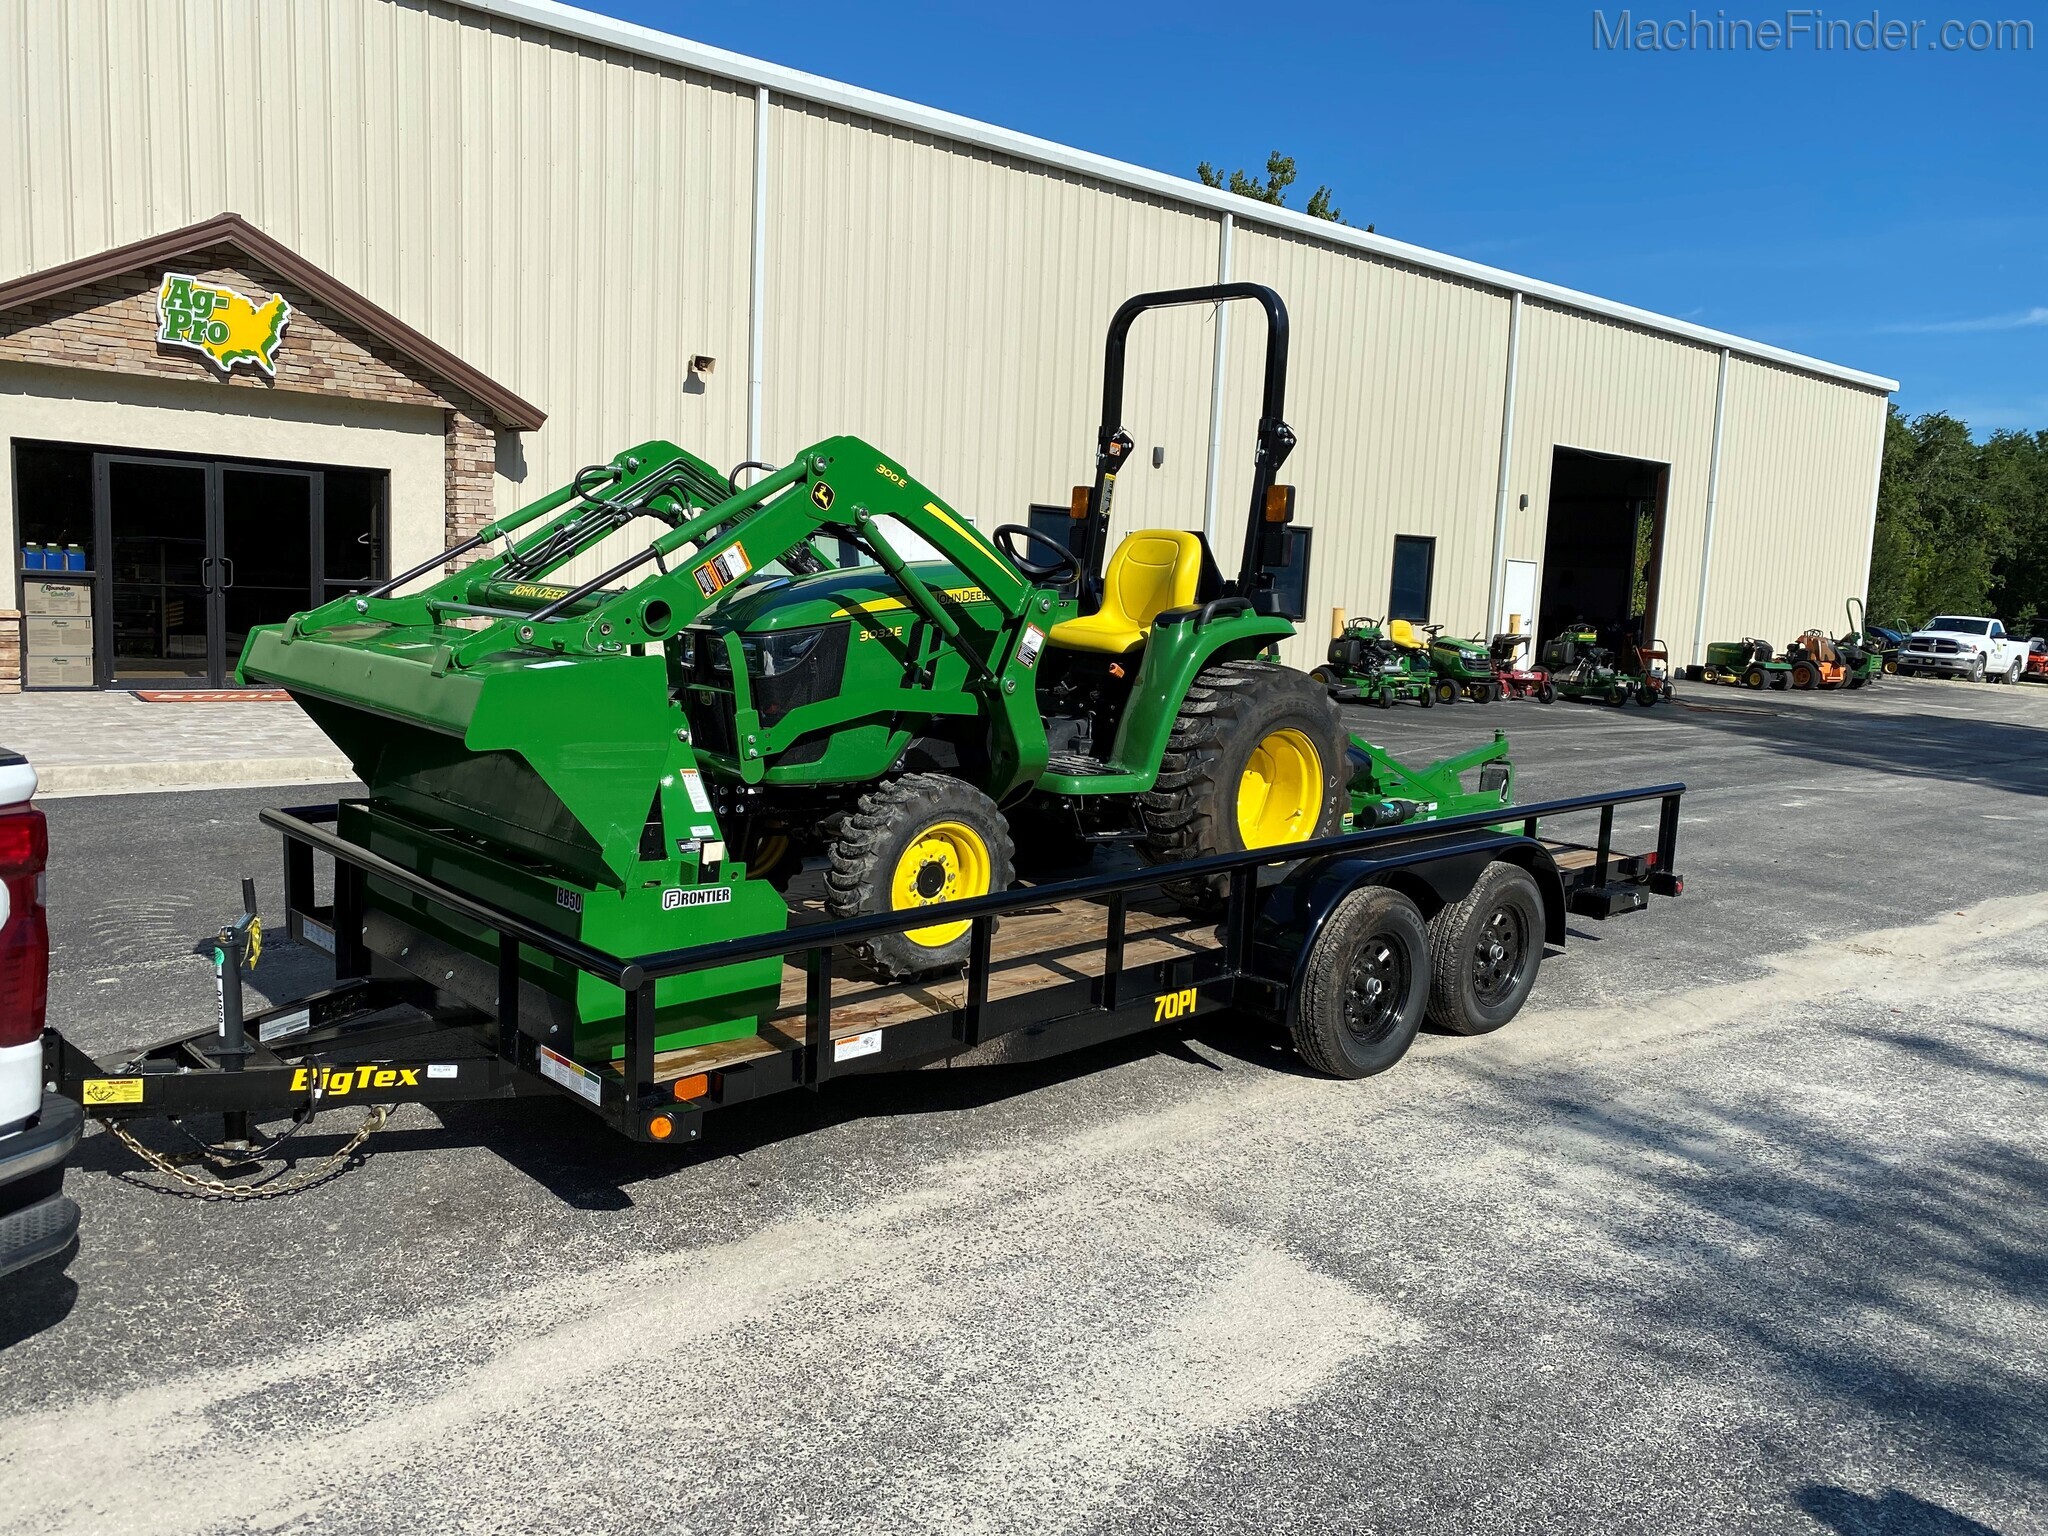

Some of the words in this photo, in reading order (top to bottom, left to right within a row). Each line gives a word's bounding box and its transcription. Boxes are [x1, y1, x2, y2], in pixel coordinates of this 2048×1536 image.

[163, 308, 230, 345] Pro
[510, 584, 538, 597] JOHN
[537, 587, 571, 600] DEER
[962, 590, 989, 601] DEER
[859, 626, 903, 642] 3032E
[557, 886, 582, 912] BB50
[664, 889, 730, 909] FRONTIER
[1154, 987, 1197, 1022] 70PI
